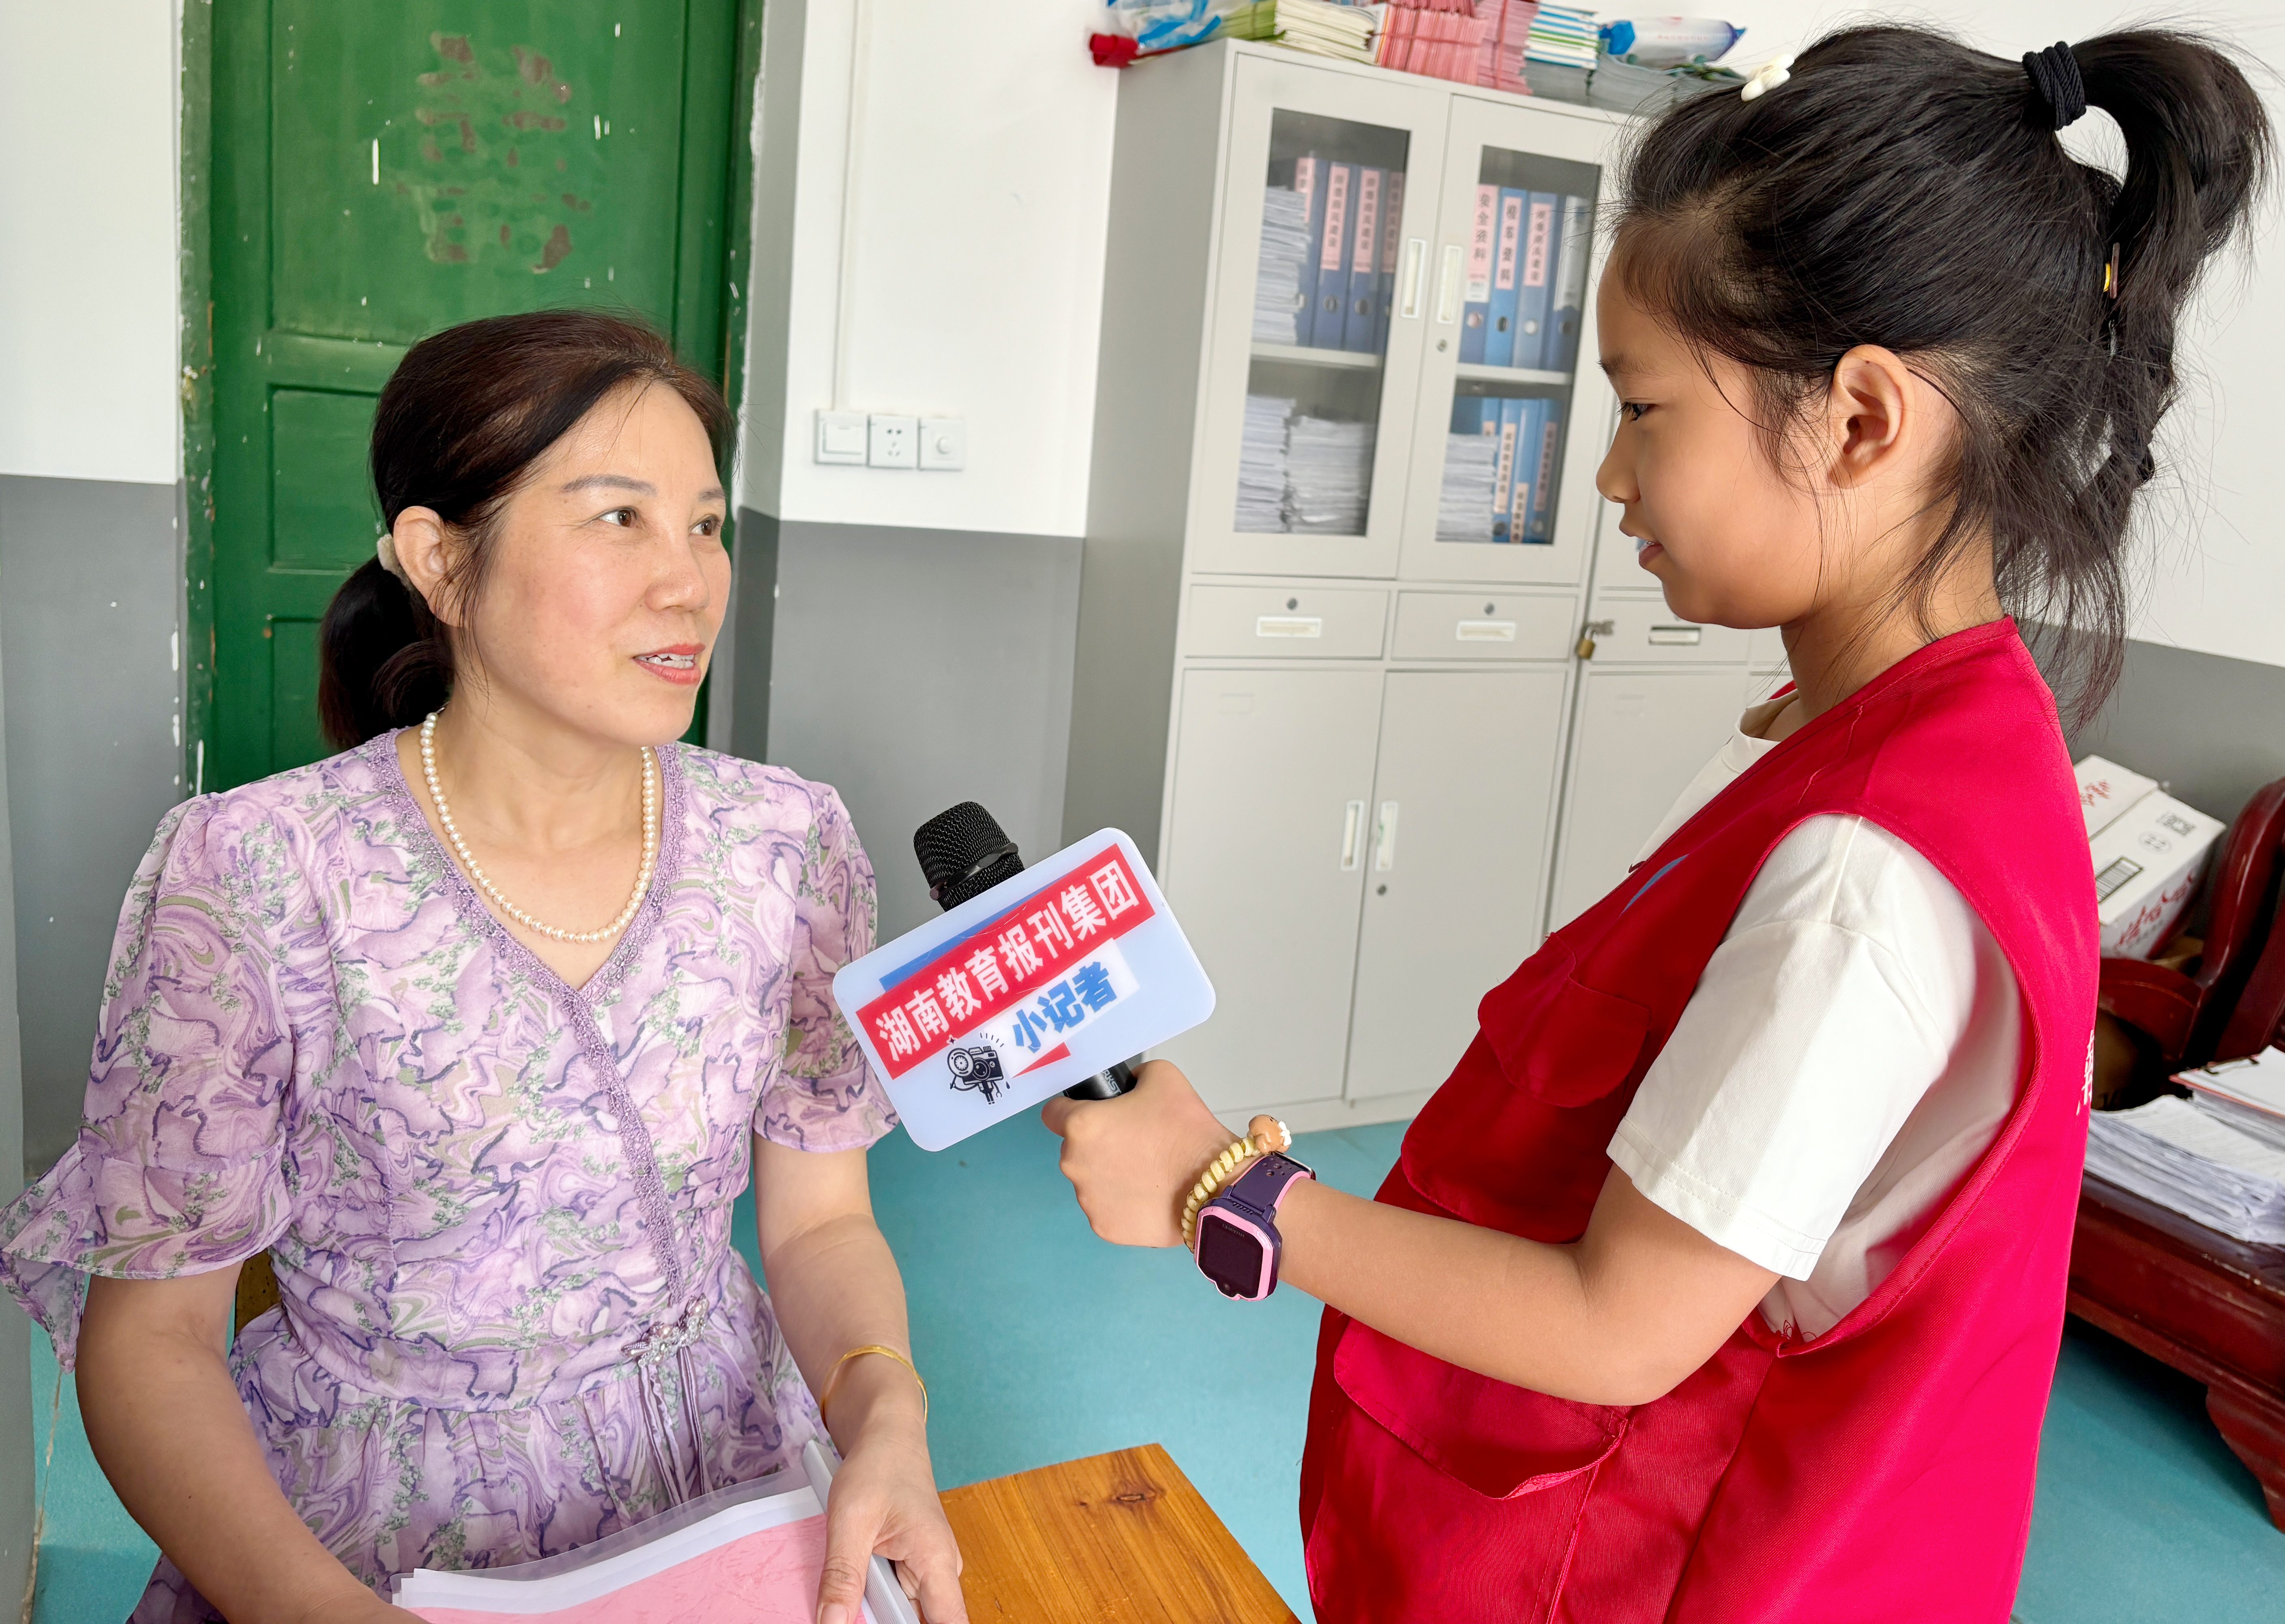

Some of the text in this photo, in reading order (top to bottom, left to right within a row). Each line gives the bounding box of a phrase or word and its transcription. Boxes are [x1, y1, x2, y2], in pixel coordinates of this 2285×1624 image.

[876, 859, 1140, 1062] 湖南教育报刊集团
[1012, 961, 1117, 1054] 小记者
[1222, 1223, 1245, 1238] HUAWEI
